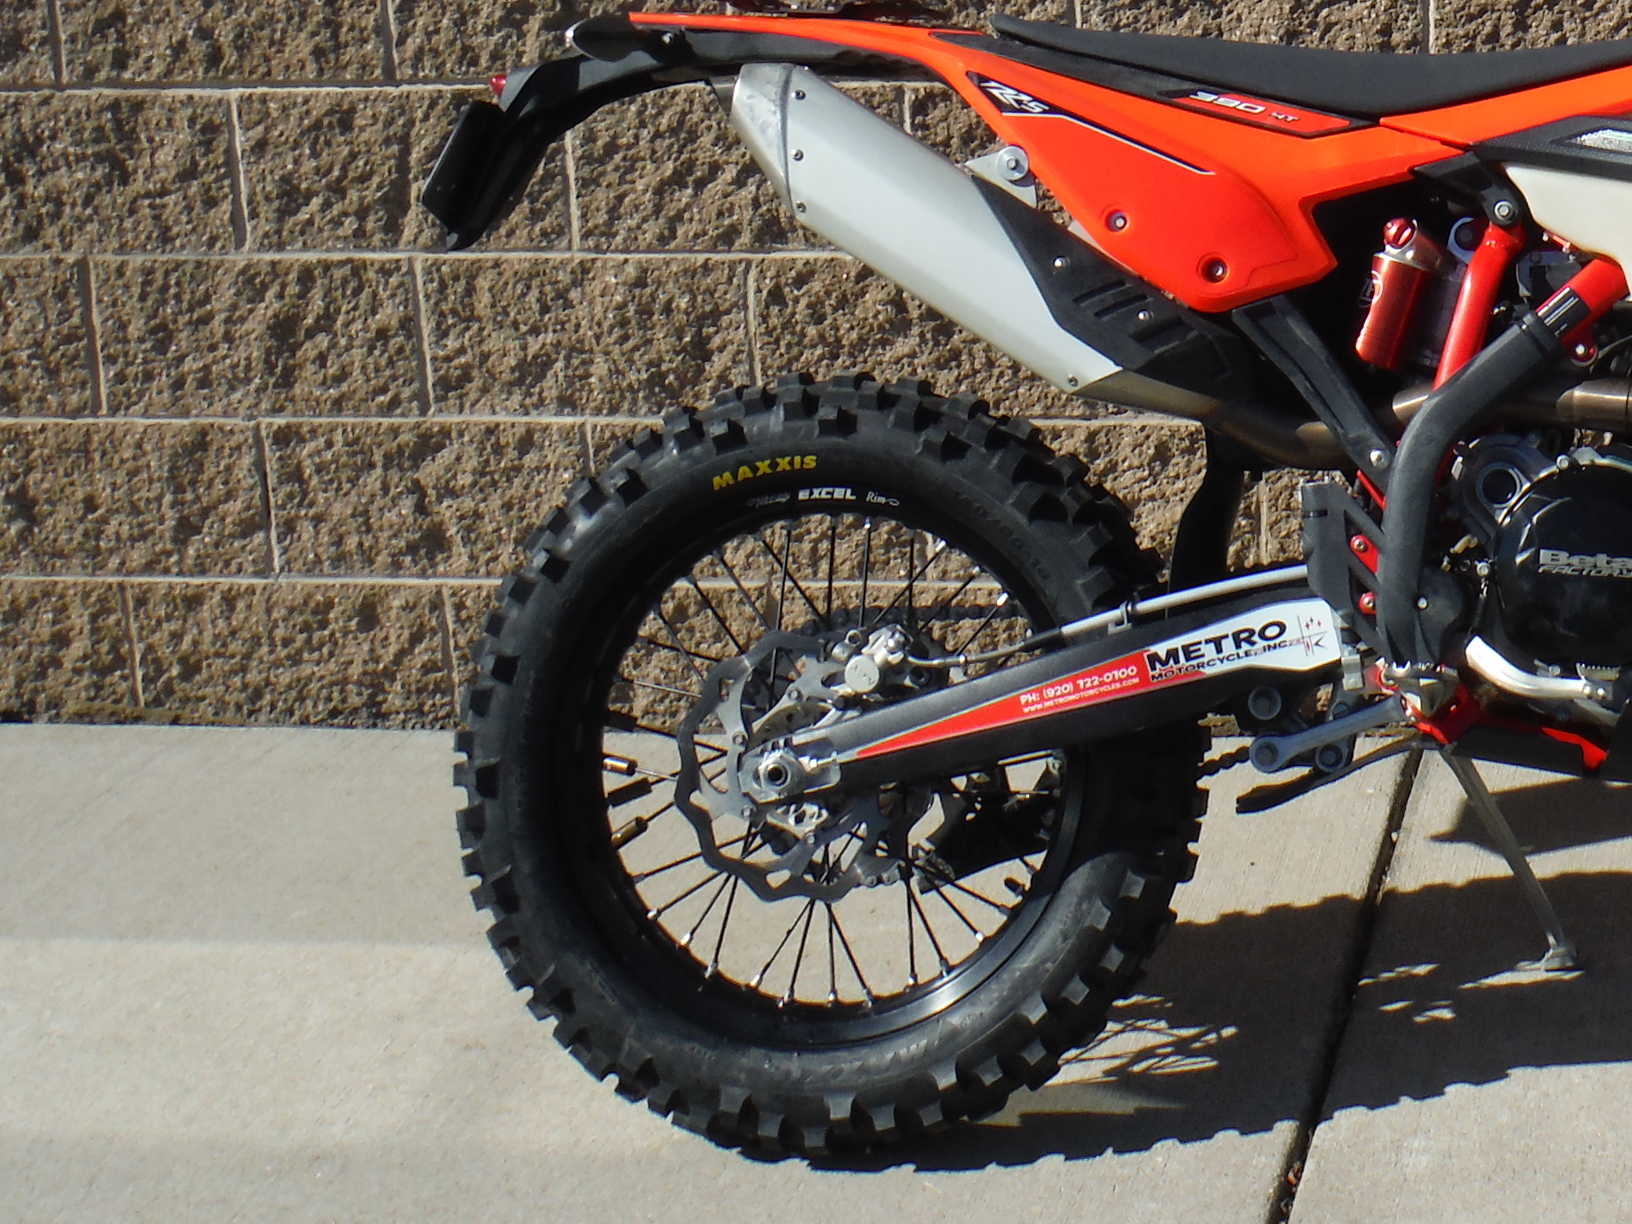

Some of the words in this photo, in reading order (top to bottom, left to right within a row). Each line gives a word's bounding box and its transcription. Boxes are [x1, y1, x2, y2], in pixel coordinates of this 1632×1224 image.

[711, 454, 818, 492] MAXXIS
[797, 486, 857, 501] EXCEL
[1146, 619, 1288, 673] METRO
[1019, 690, 1041, 706] PH:
[1042, 679, 1074, 700] (920)
